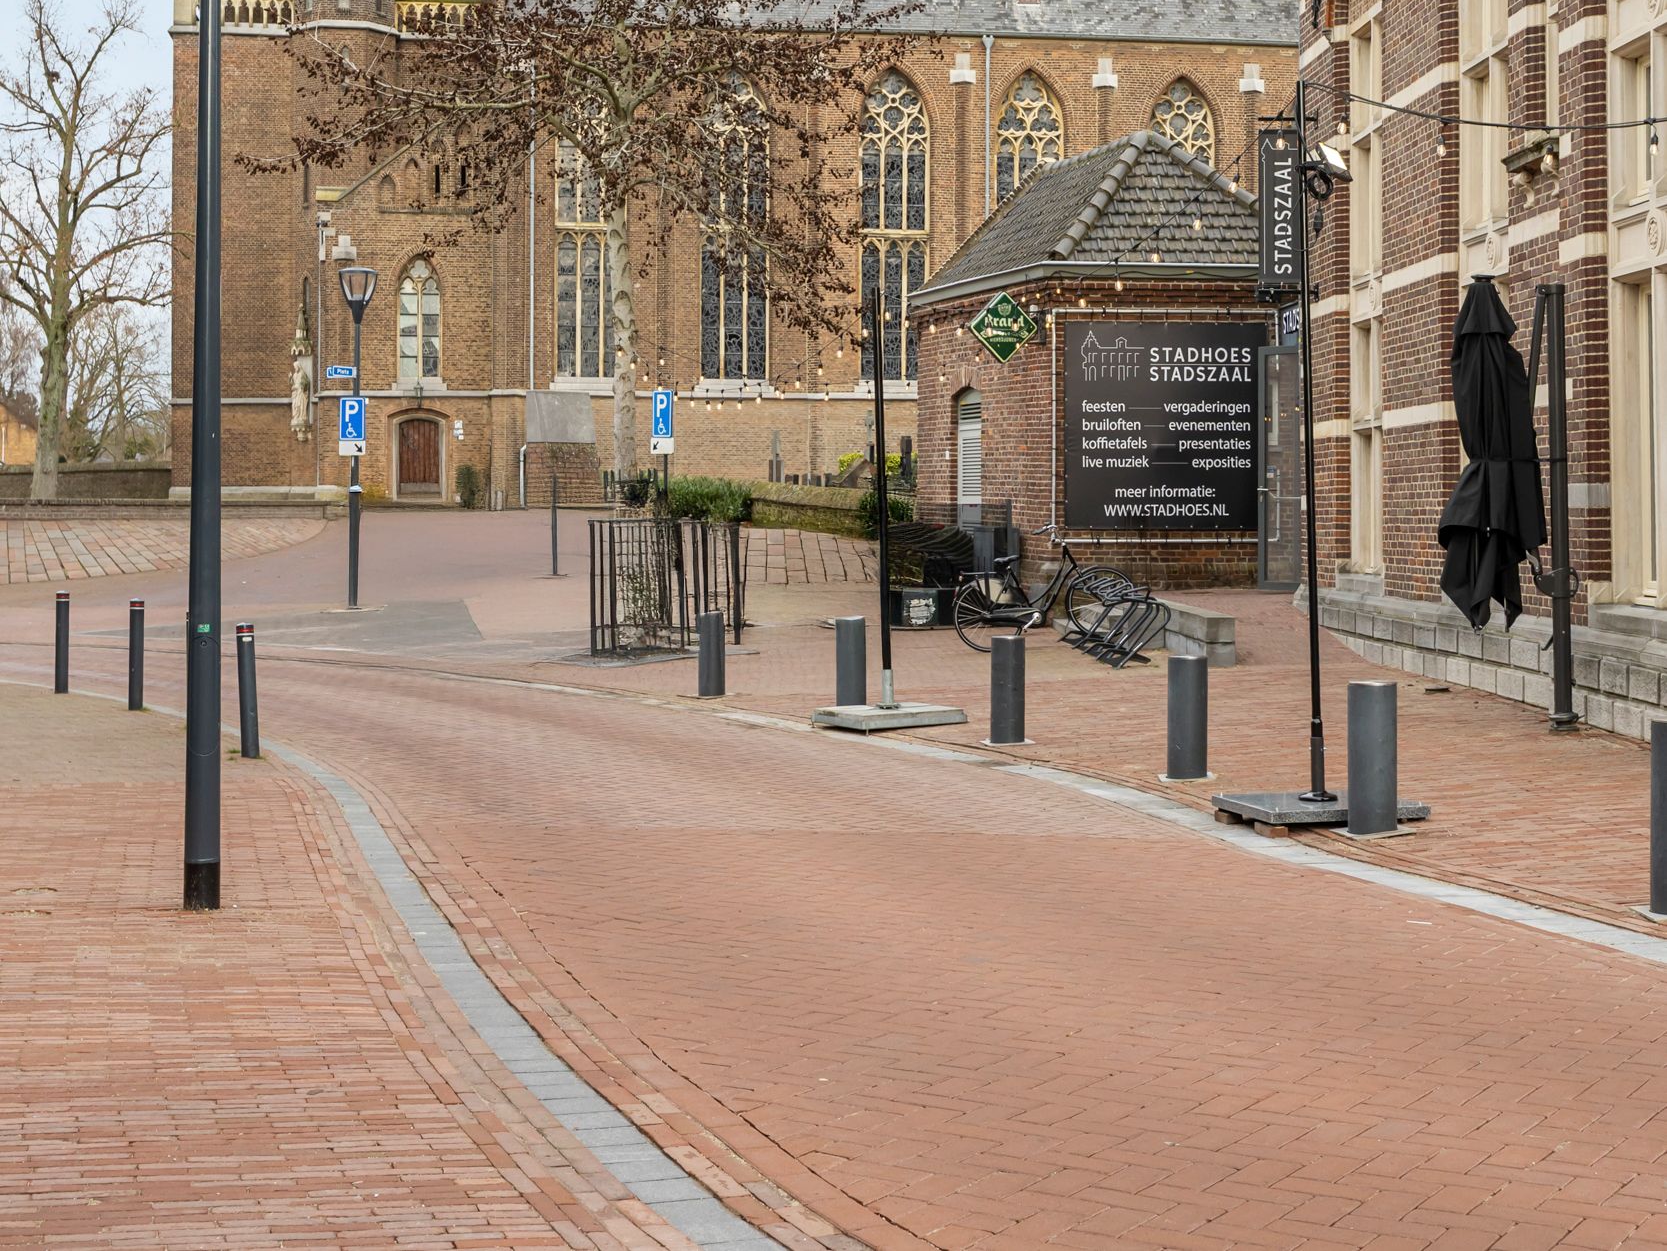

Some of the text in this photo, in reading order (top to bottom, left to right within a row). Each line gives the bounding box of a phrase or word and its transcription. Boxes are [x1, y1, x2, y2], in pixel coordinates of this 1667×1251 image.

[1274, 157, 1292, 275] STADSZAAL
[1150, 347, 1251, 363] STADHOES
[1149, 367, 1252, 382] STADSZAAL
[345, 400, 359, 422] P
[656, 394, 667, 418] P
[1082, 400, 1251, 415] feesten vergaderingen
[1082, 418, 1251, 431] bruiloften evenementen
[1082, 437, 1251, 452] koffietafels presentaties
[1082, 455, 1251, 470] live muziek exposities
[1115, 485, 1216, 498] meer informatie:
[1104, 504, 1230, 517] WWW.STADHOES.NL
